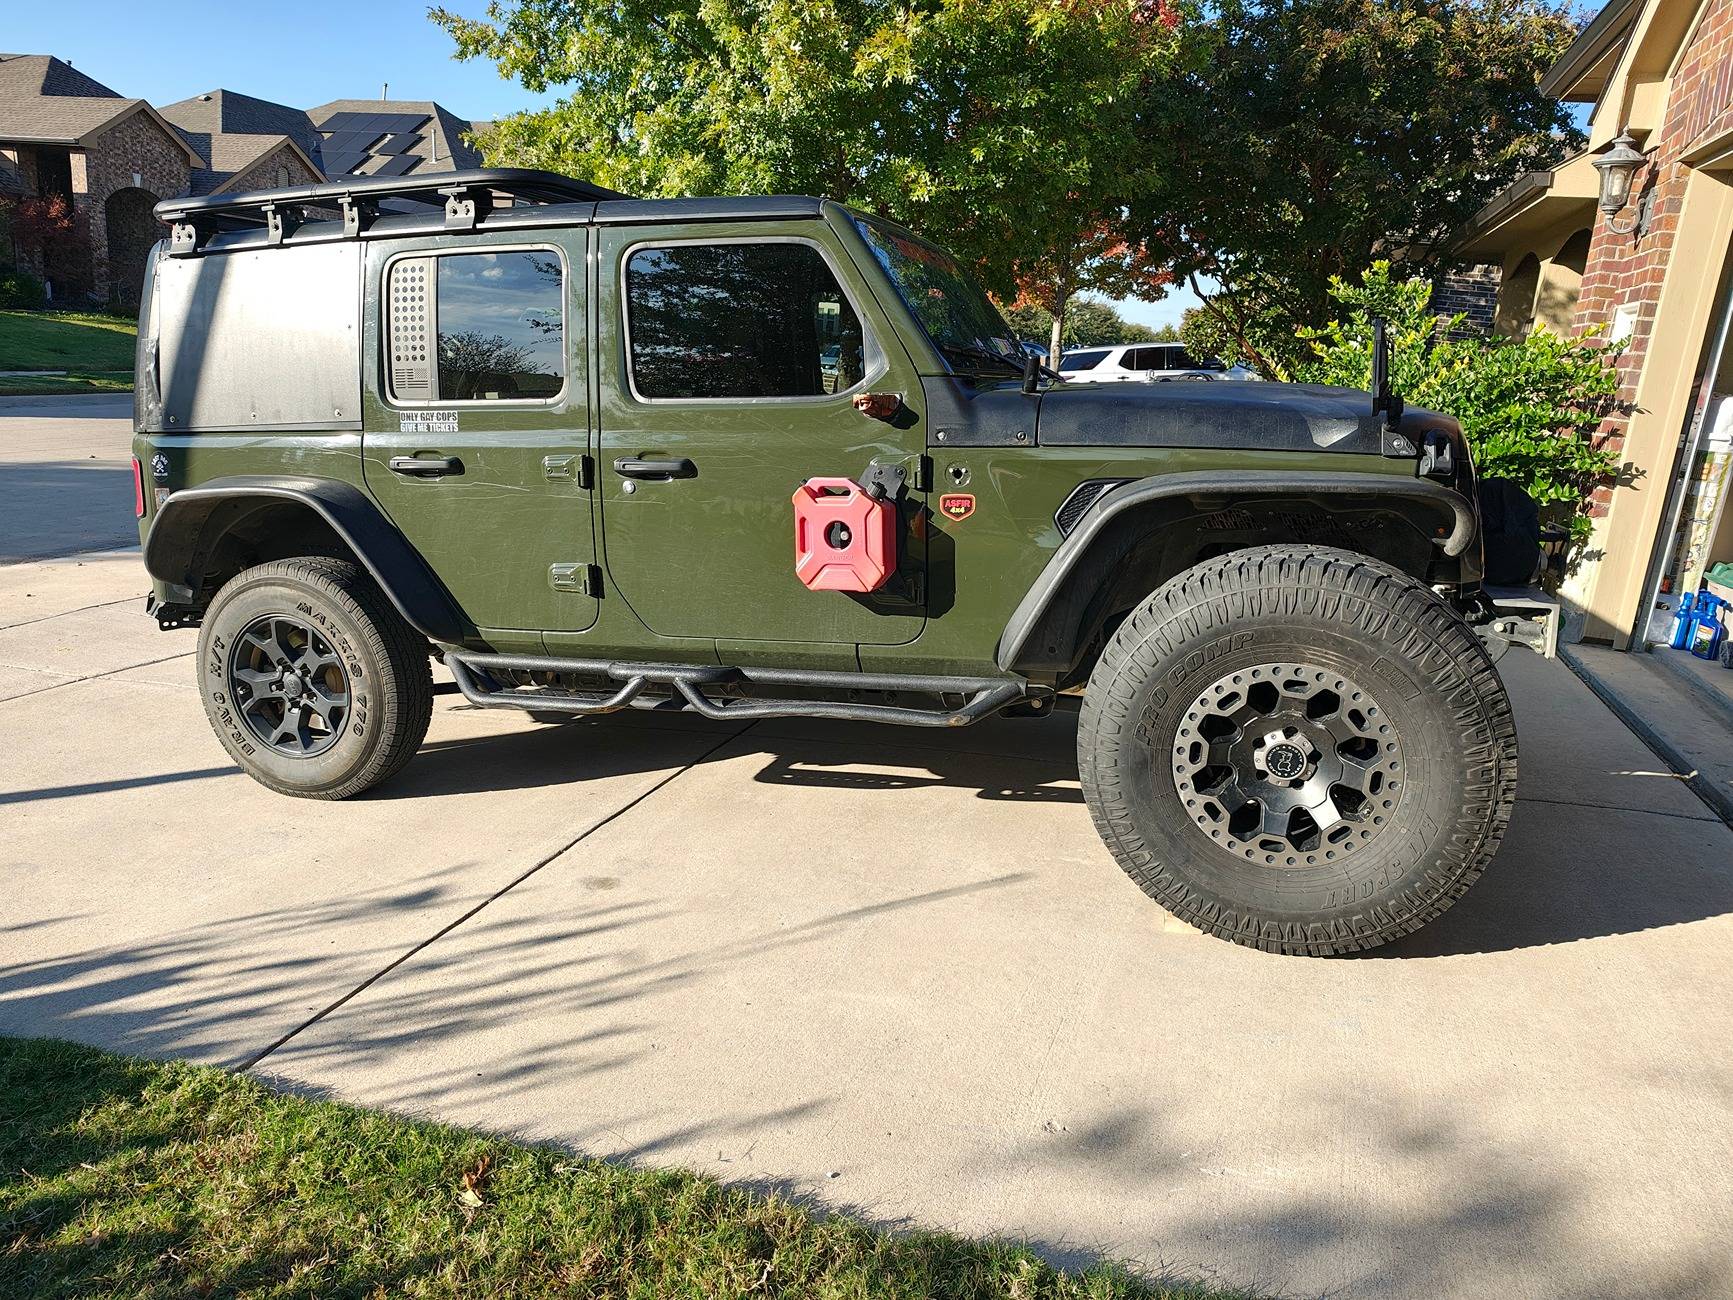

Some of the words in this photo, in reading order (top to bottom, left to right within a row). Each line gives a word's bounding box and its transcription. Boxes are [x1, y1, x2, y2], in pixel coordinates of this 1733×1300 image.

[400, 411, 418, 421] ONLY
[420, 411, 434, 421] GAY
[436, 411, 457, 421] COPS
[400, 423, 417, 432] GIVE
[418, 423, 428, 432] ME
[429, 423, 458, 432] TICKETS
[208, 634, 228, 678] H/T
[296, 601, 363, 678] MAXXIS
[352, 695, 368, 738] 770
[1134, 686, 1169, 746] PRO
[1167, 631, 1254, 688] COMP
[213, 691, 255, 757] BRAVO
[1319, 858, 1405, 911] SPORT
